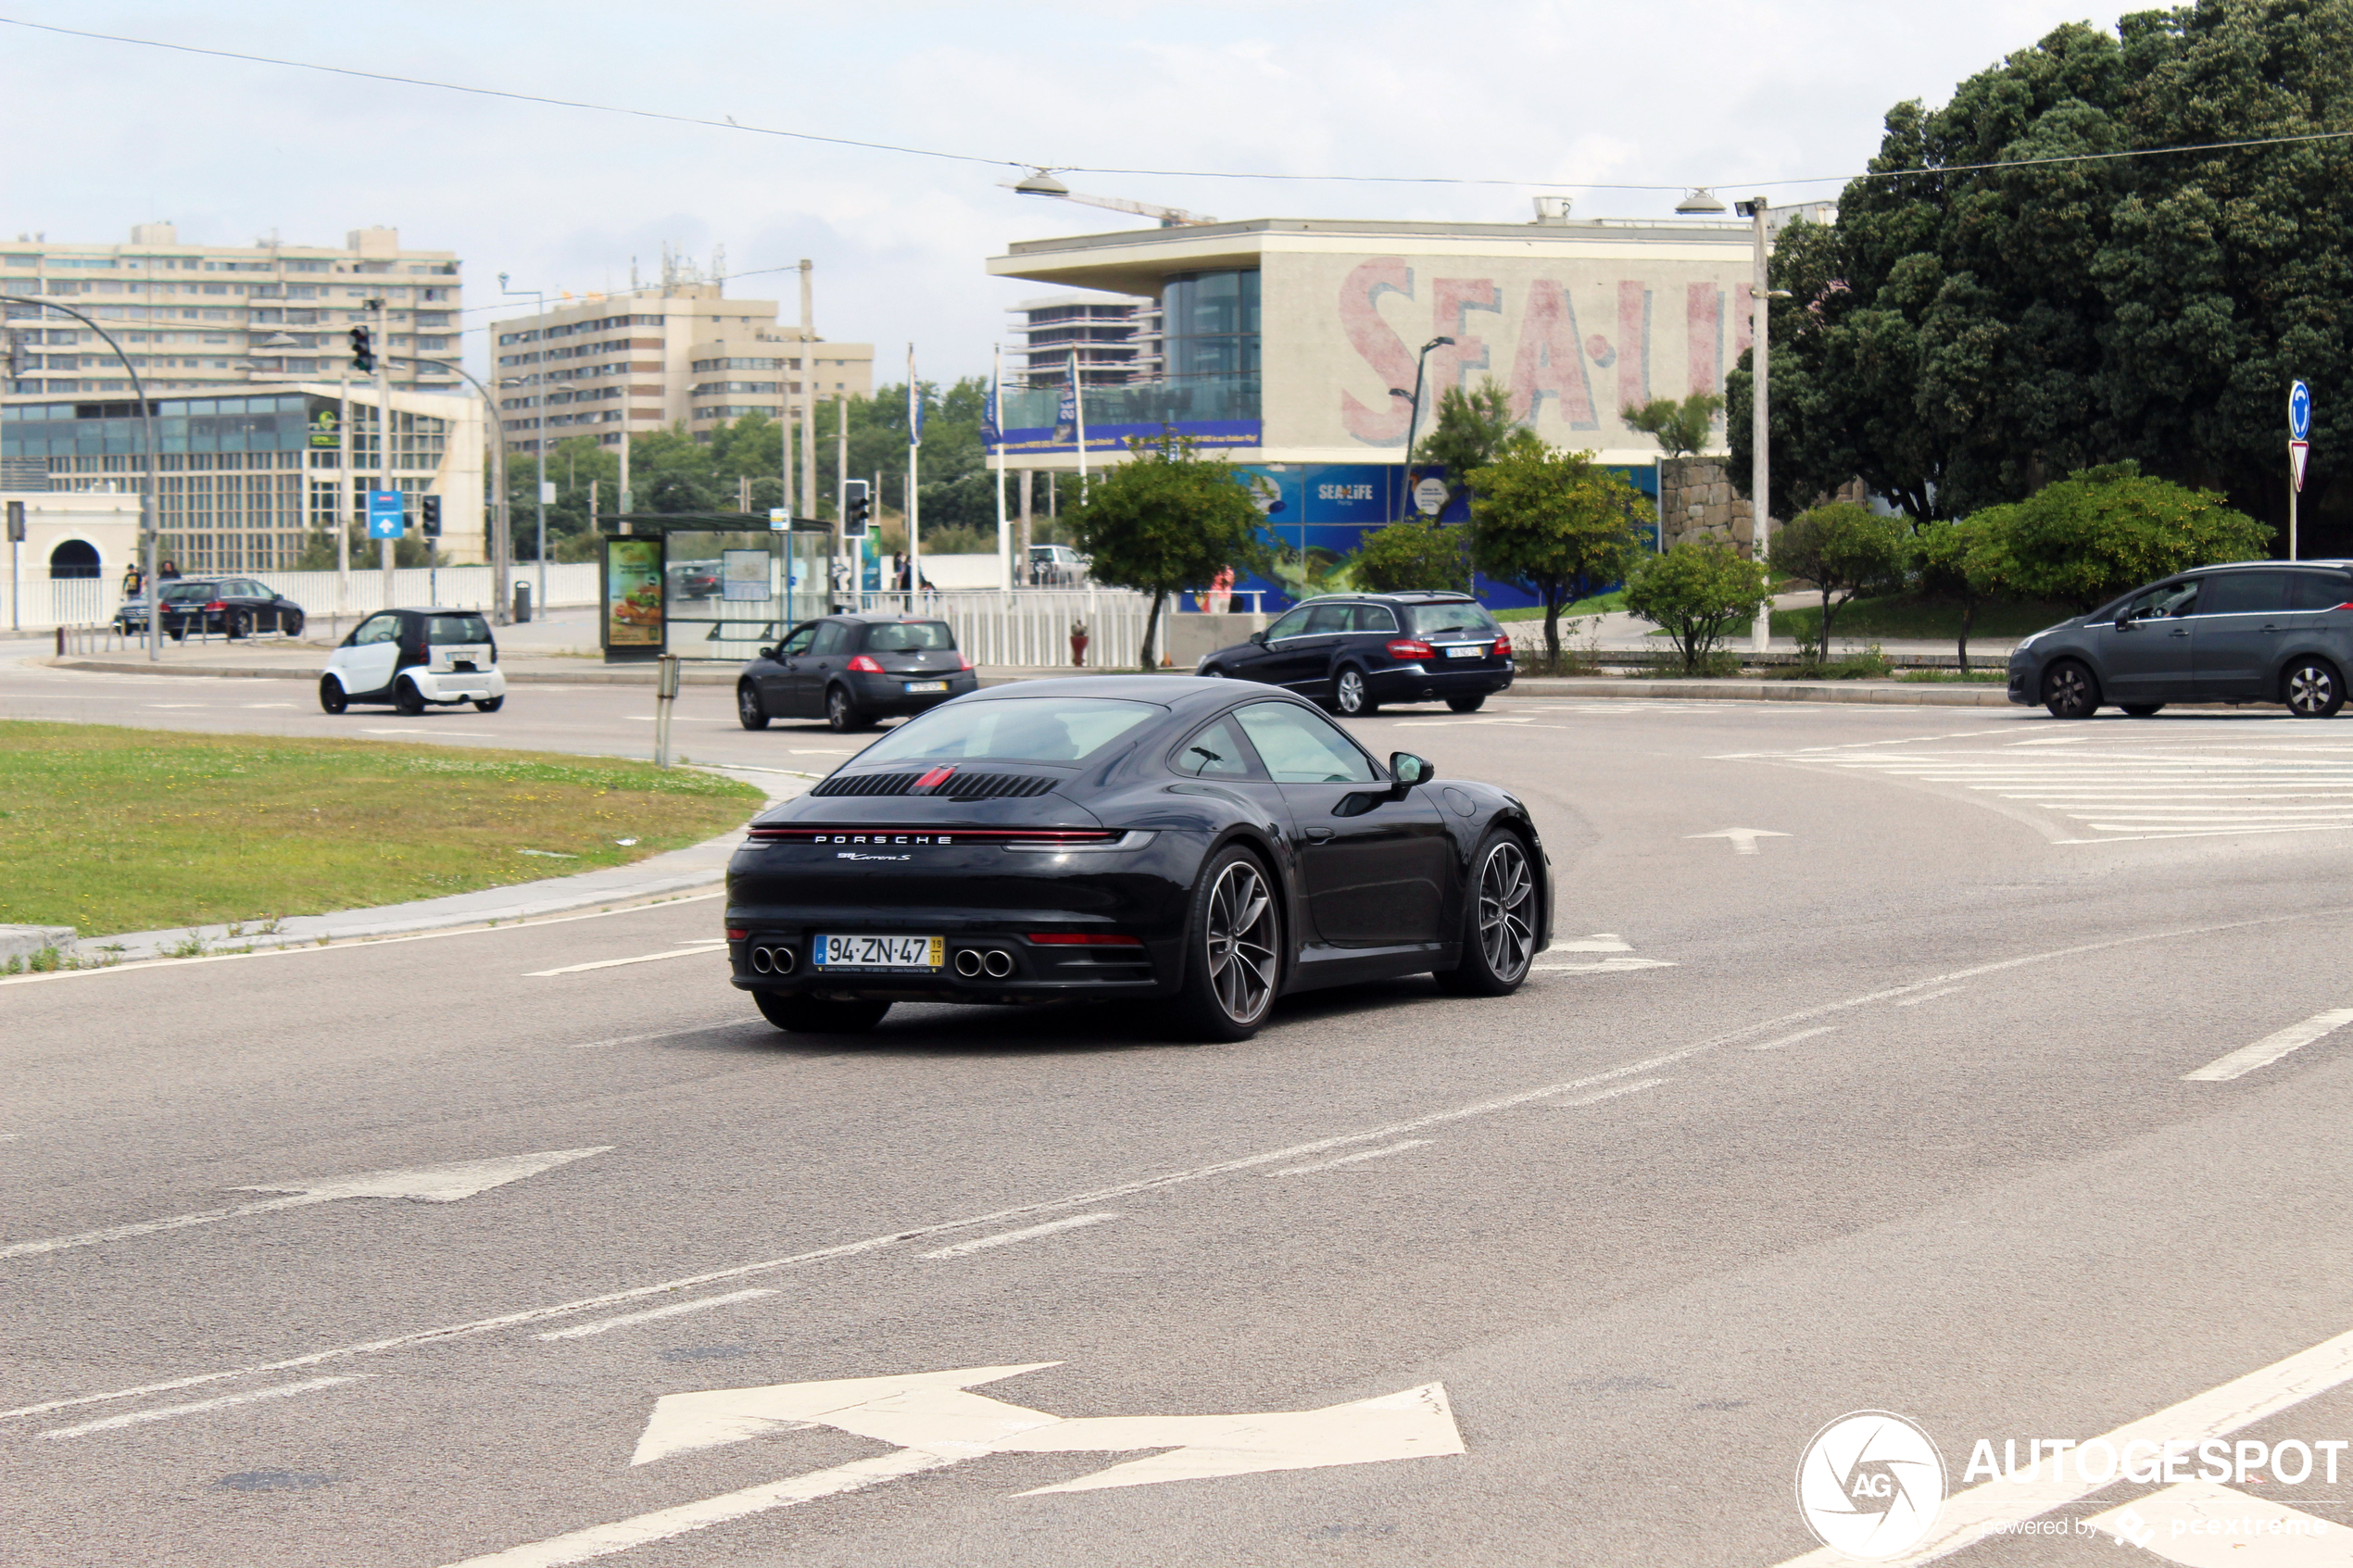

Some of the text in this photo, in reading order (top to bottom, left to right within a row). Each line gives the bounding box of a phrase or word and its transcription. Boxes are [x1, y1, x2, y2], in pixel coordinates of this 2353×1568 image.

[815, 835, 951, 844] PORSCHE
[932, 939, 942, 948] 19
[931, 955, 940, 963] 11
